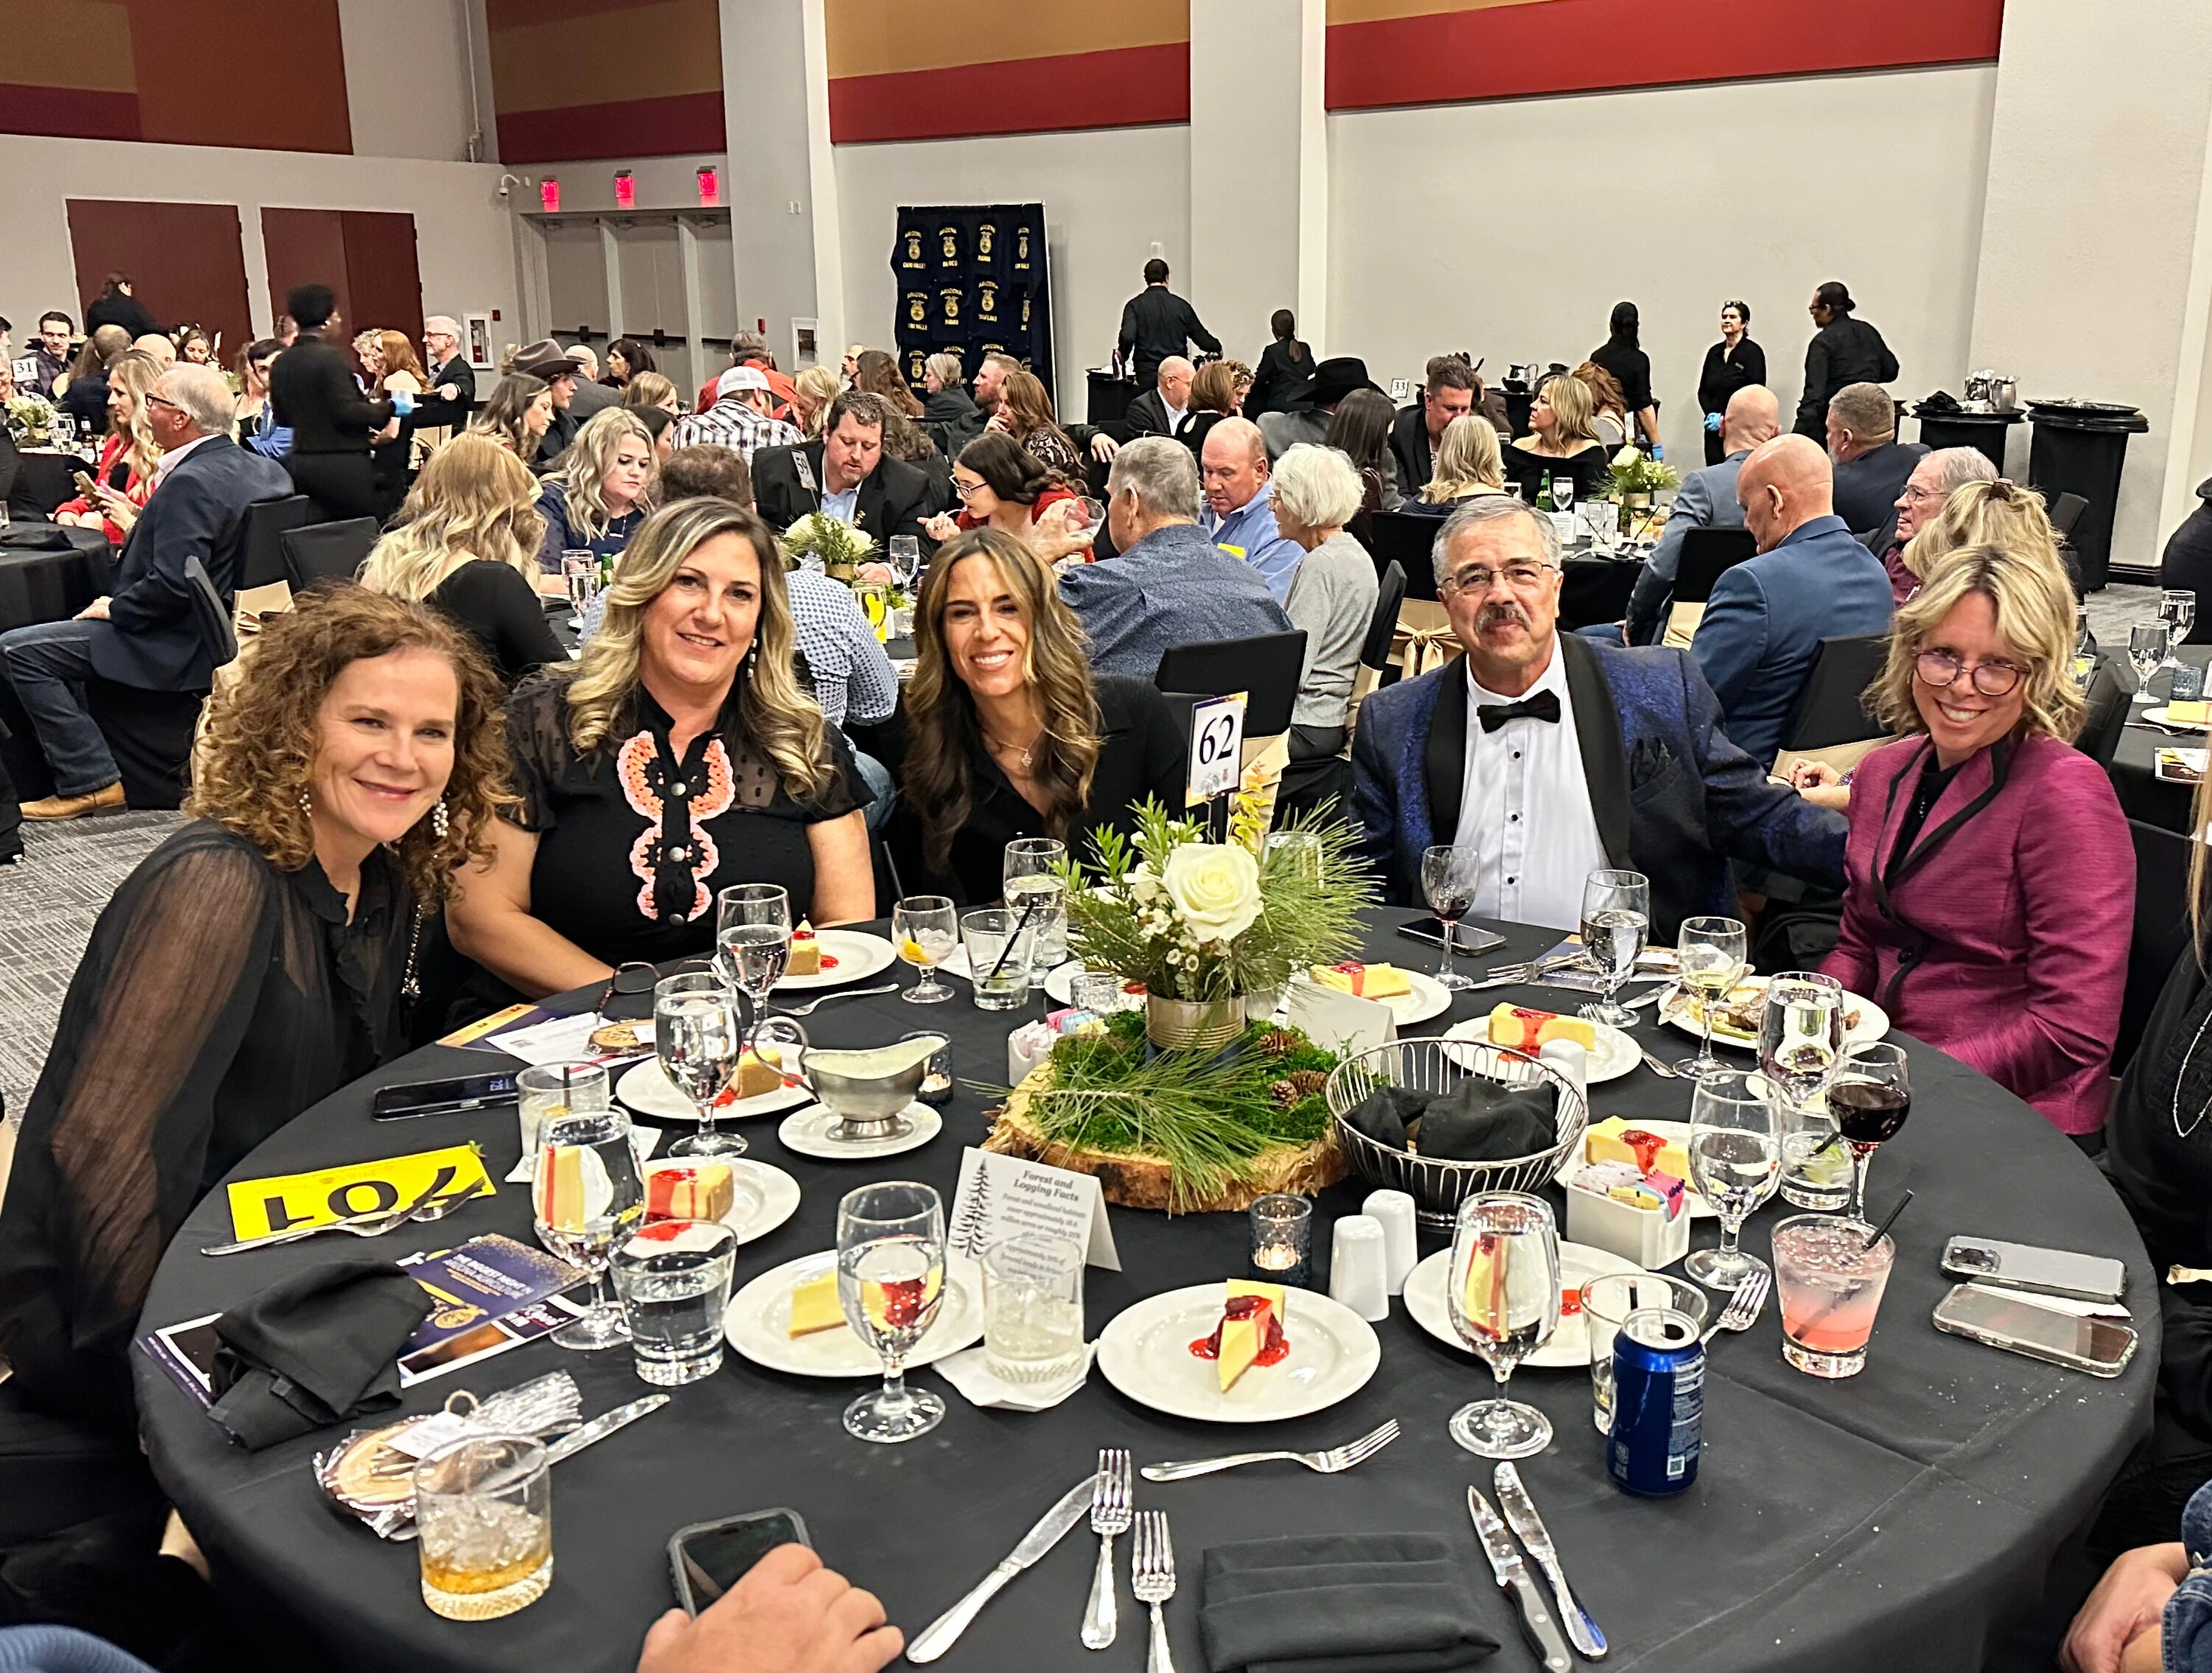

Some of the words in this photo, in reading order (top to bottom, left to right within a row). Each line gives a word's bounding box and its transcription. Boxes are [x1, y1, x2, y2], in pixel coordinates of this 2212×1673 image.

[16, 362, 32, 373] 31
[1393, 381, 1406, 391] 33
[795, 456, 809, 475] 59
[1199, 713, 1235, 766] 62
[1022, 1169, 1053, 1184] Forest
[1053, 1179, 1073, 1189] and
[1013, 1178, 1052, 1197] Logging
[1053, 1187, 1079, 1202] Facts
[466, 1260, 503, 1279] BIGGEST
[496, 1274, 527, 1290] NIGHT
